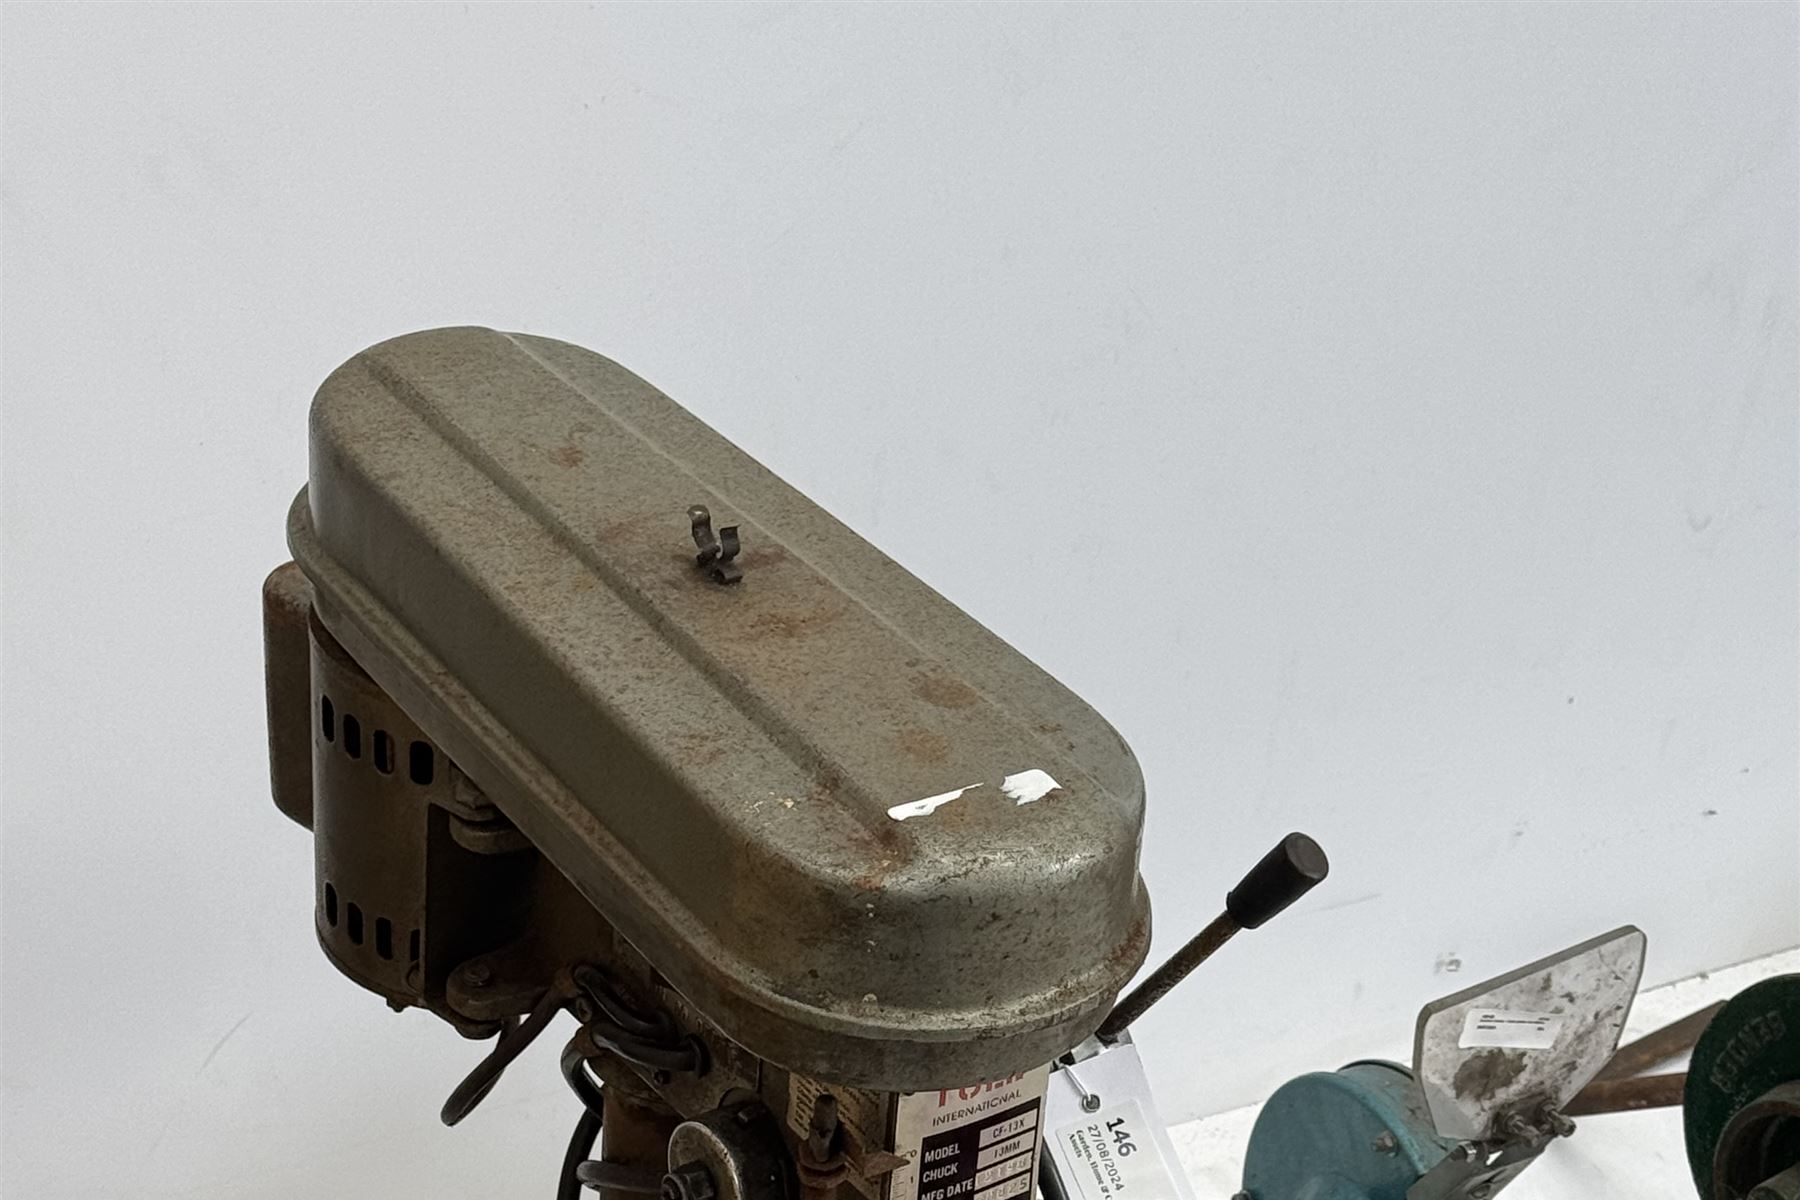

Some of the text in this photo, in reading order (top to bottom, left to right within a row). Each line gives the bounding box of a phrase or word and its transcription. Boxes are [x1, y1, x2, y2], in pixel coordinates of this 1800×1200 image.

[932, 1089, 1021, 1127] INTERNATIONAL
[993, 1118, 1025, 1138] CF-13X
[1106, 1117, 1138, 1157] 146
[925, 1143, 960, 1163] MODEL
[994, 1140, 1021, 1158] 13MM
[1067, 1132, 1083, 1158] Assets
[1074, 1129, 1095, 1161] Garden,
[1089, 1161, 1106, 1185] Home
[1087, 1125, 1124, 1191] 27/08/2024
[922, 1162, 959, 1183] CHUCK
[947, 1178, 974, 1198] DATE
